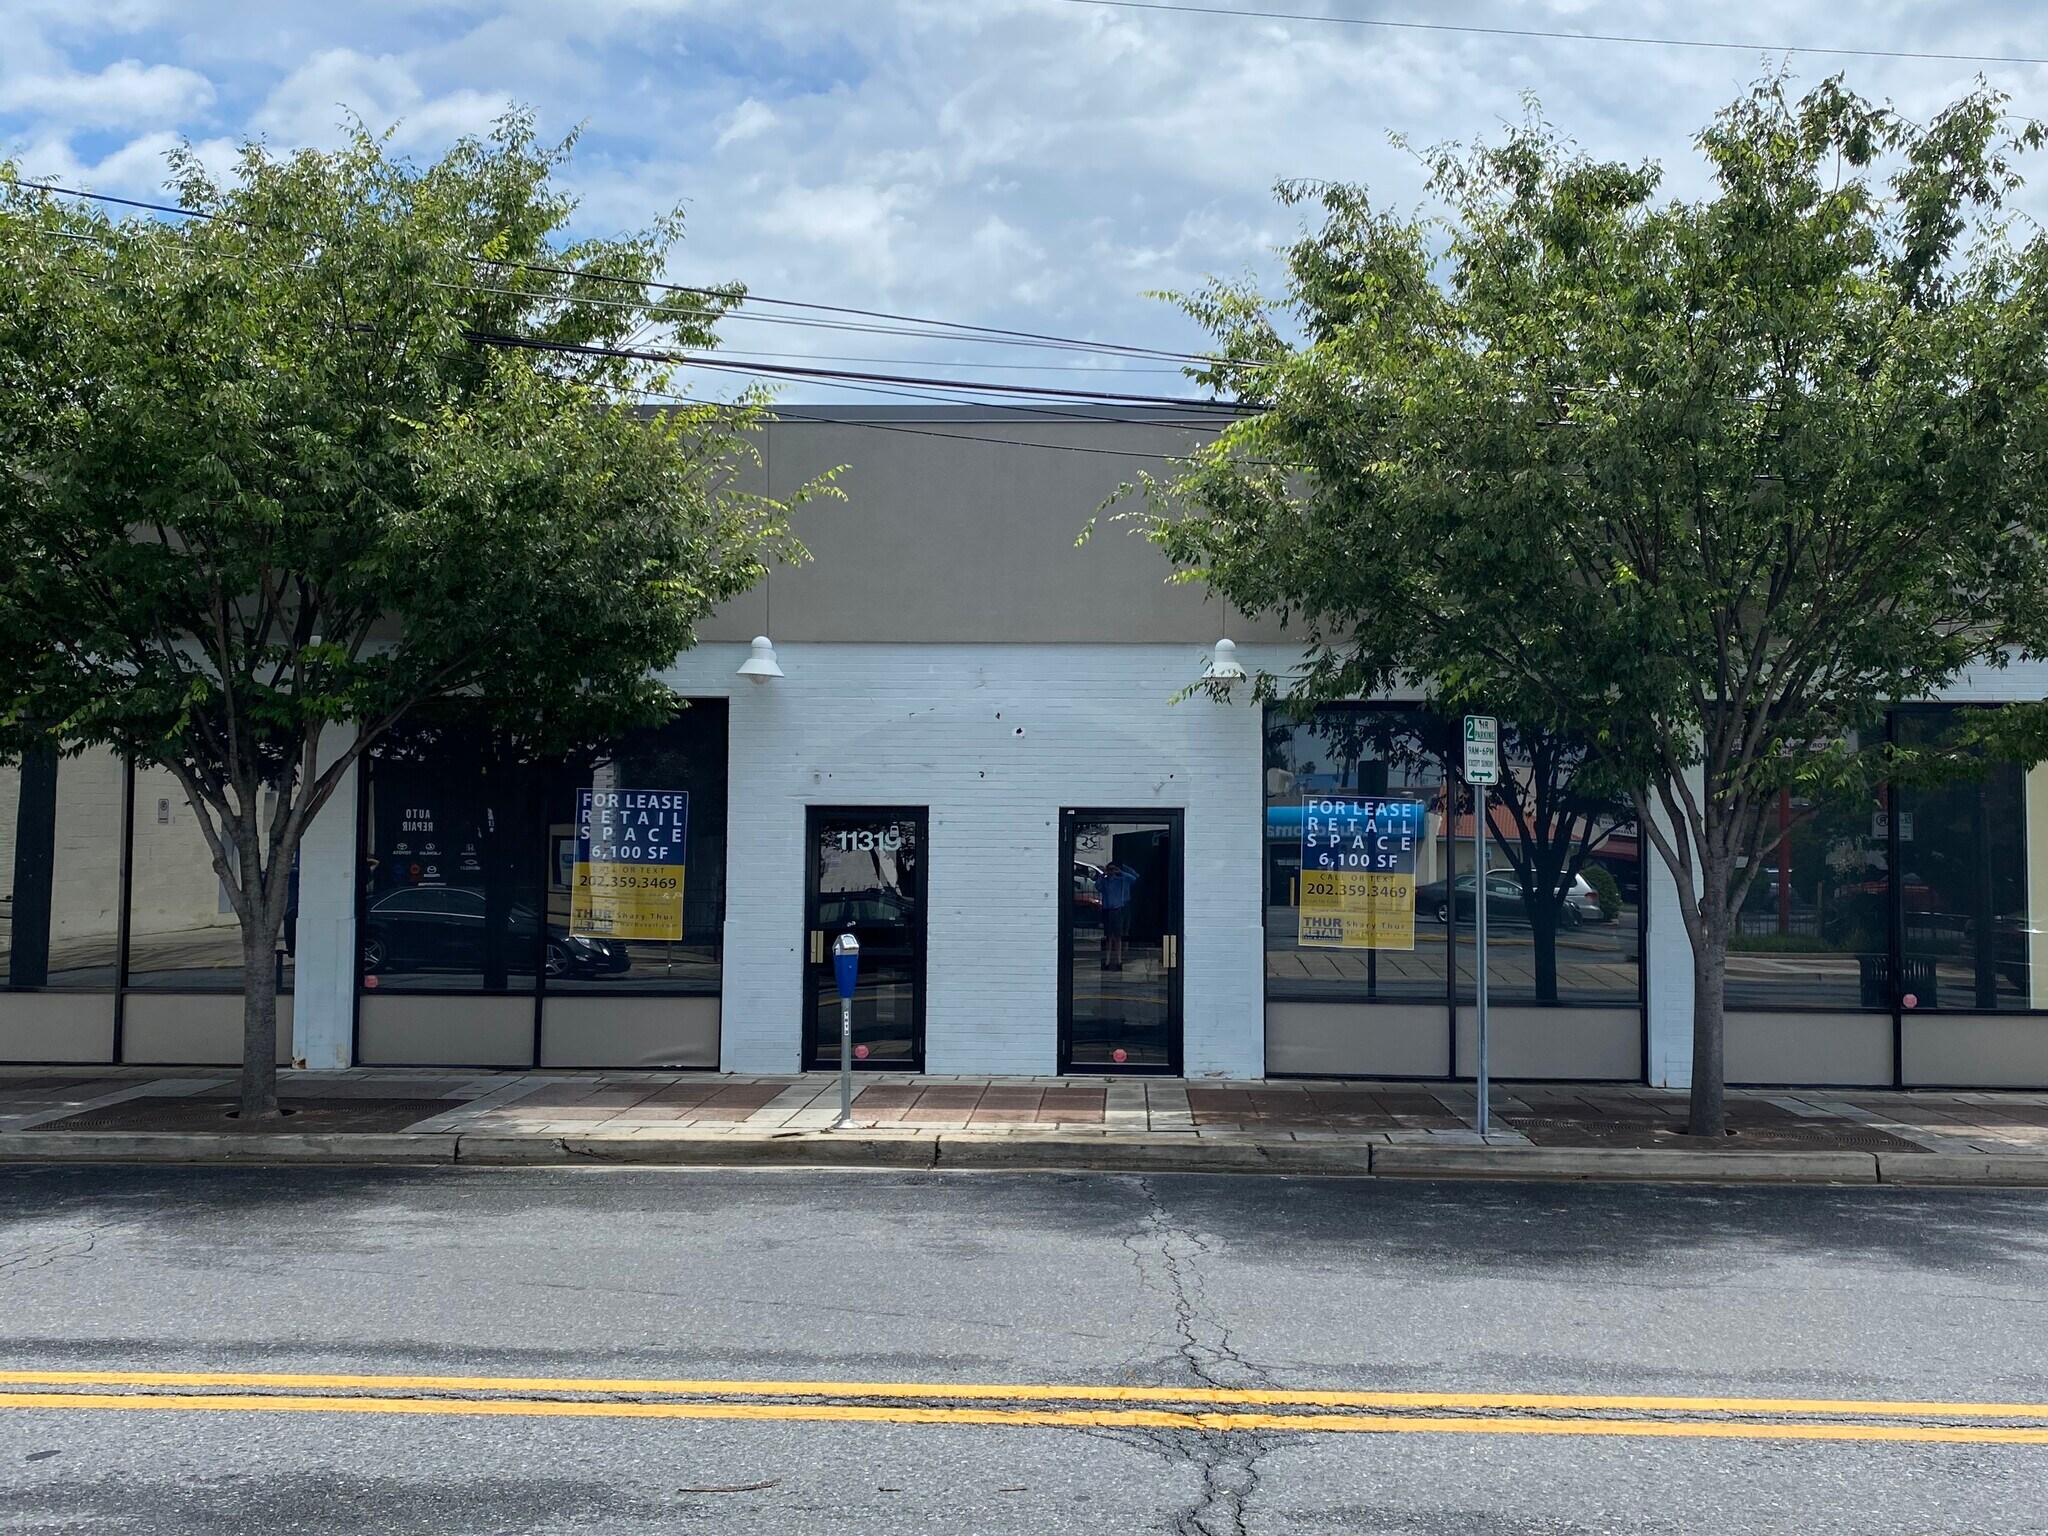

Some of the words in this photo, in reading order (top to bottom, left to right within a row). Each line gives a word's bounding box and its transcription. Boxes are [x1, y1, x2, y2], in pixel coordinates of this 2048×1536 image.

[1467, 721, 1474, 739] 2
[1480, 721, 1489, 730] HR
[1475, 731, 1495, 740] PARKING
[582, 793, 619, 808] FOR
[625, 794, 683, 810] LEASE
[1308, 800, 1346, 815] FOR
[1353, 801, 1411, 817] LEASE
[581, 809, 683, 826] RETAIL
[1307, 817, 1412, 834] RETAIL
[580, 826, 682, 843] SPACE
[837, 830, 902, 851] 11319
[1307, 834, 1411, 851] SPACE
[591, 845, 641, 860] 6,100
[647, 846, 669, 860] SF
[1318, 852, 1370, 867] 6,100
[1377, 854, 1398, 868] SF
[579, 875, 677, 889] 202.359.3469
[1320, 873, 1345, 881] CALL
[1306, 883, 1407, 898] 202.359.3469
[575, 908, 612, 919] THUR
[650, 912, 674, 920] Thur
[1303, 916, 1342, 928] THUR
[1346, 920, 1377, 930] Shary
[1381, 921, 1406, 930] Thur
[1303, 928, 1343, 937] RETAIL
